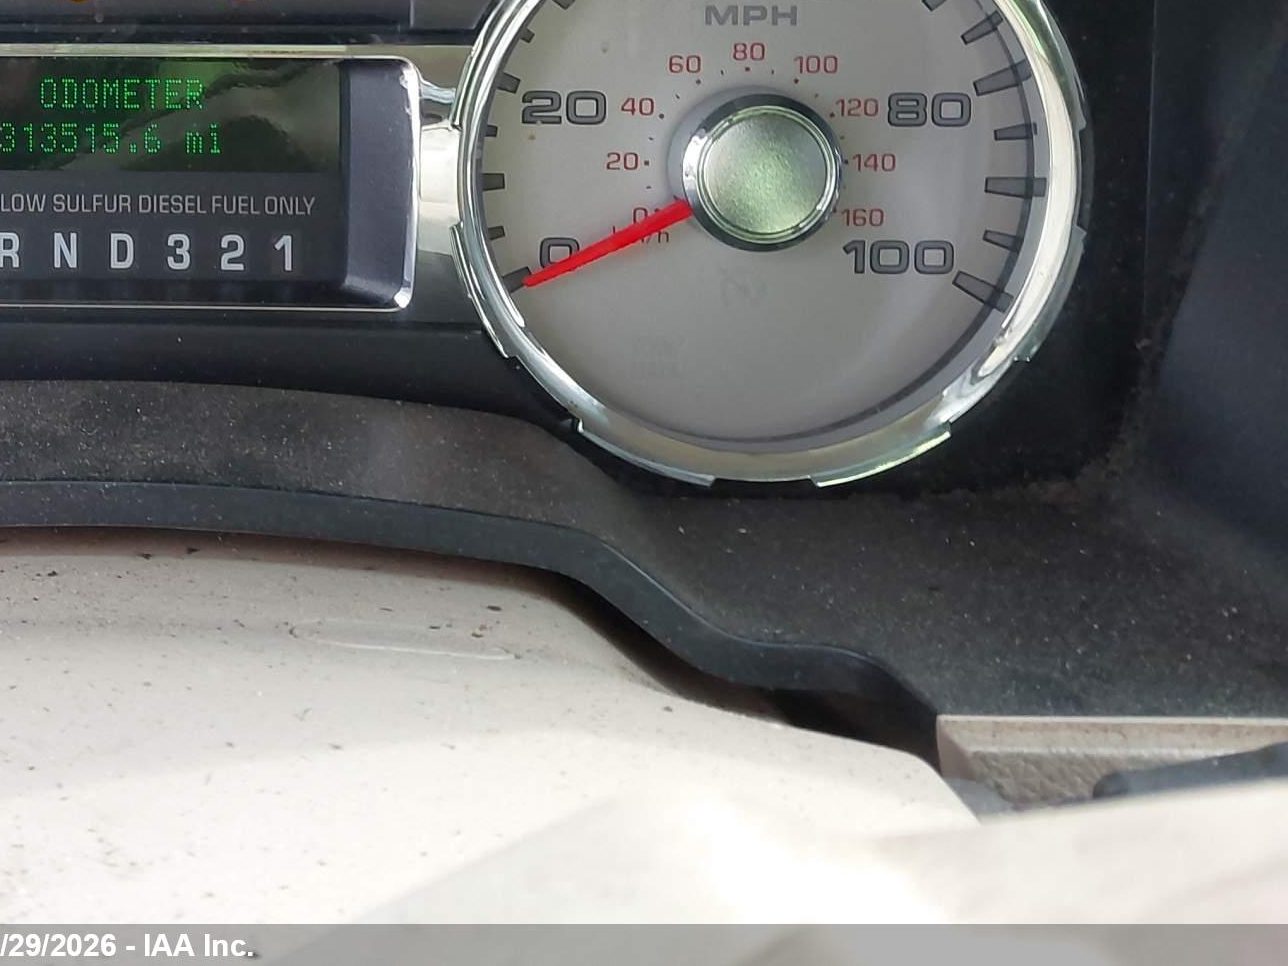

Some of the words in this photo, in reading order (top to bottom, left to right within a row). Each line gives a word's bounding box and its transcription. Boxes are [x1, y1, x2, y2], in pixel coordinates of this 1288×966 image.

[705, 5, 798, 27] MPH
[732, 42, 766, 62] 80
[668, 55, 702, 74] 60
[796, 54, 839, 74] 100
[39, 78, 203, 110] ODOMETER
[521, 90, 607, 126] 20
[621, 97, 655, 116] 40
[838, 98, 879, 117] 120
[887, 92, 972, 128] 80
[185, 123, 222, 154] mi
[606, 152, 640, 170] 20
[853, 153, 896, 172] 140
[0, 194, 46, 213] LOW
[53, 194, 131, 214] SULFUR
[138, 195, 206, 214] DIESEL
[212, 195, 260, 215] FUEL
[264, 196, 315, 215] ONLY
[843, 208, 884, 227] 160
[53, 233, 77, 268] N
[110, 233, 134, 269] D
[167, 234, 191, 269] 3
[220, 234, 245, 270] 2
[274, 235, 293, 270] 1
[843, 240, 954, 274] 100
